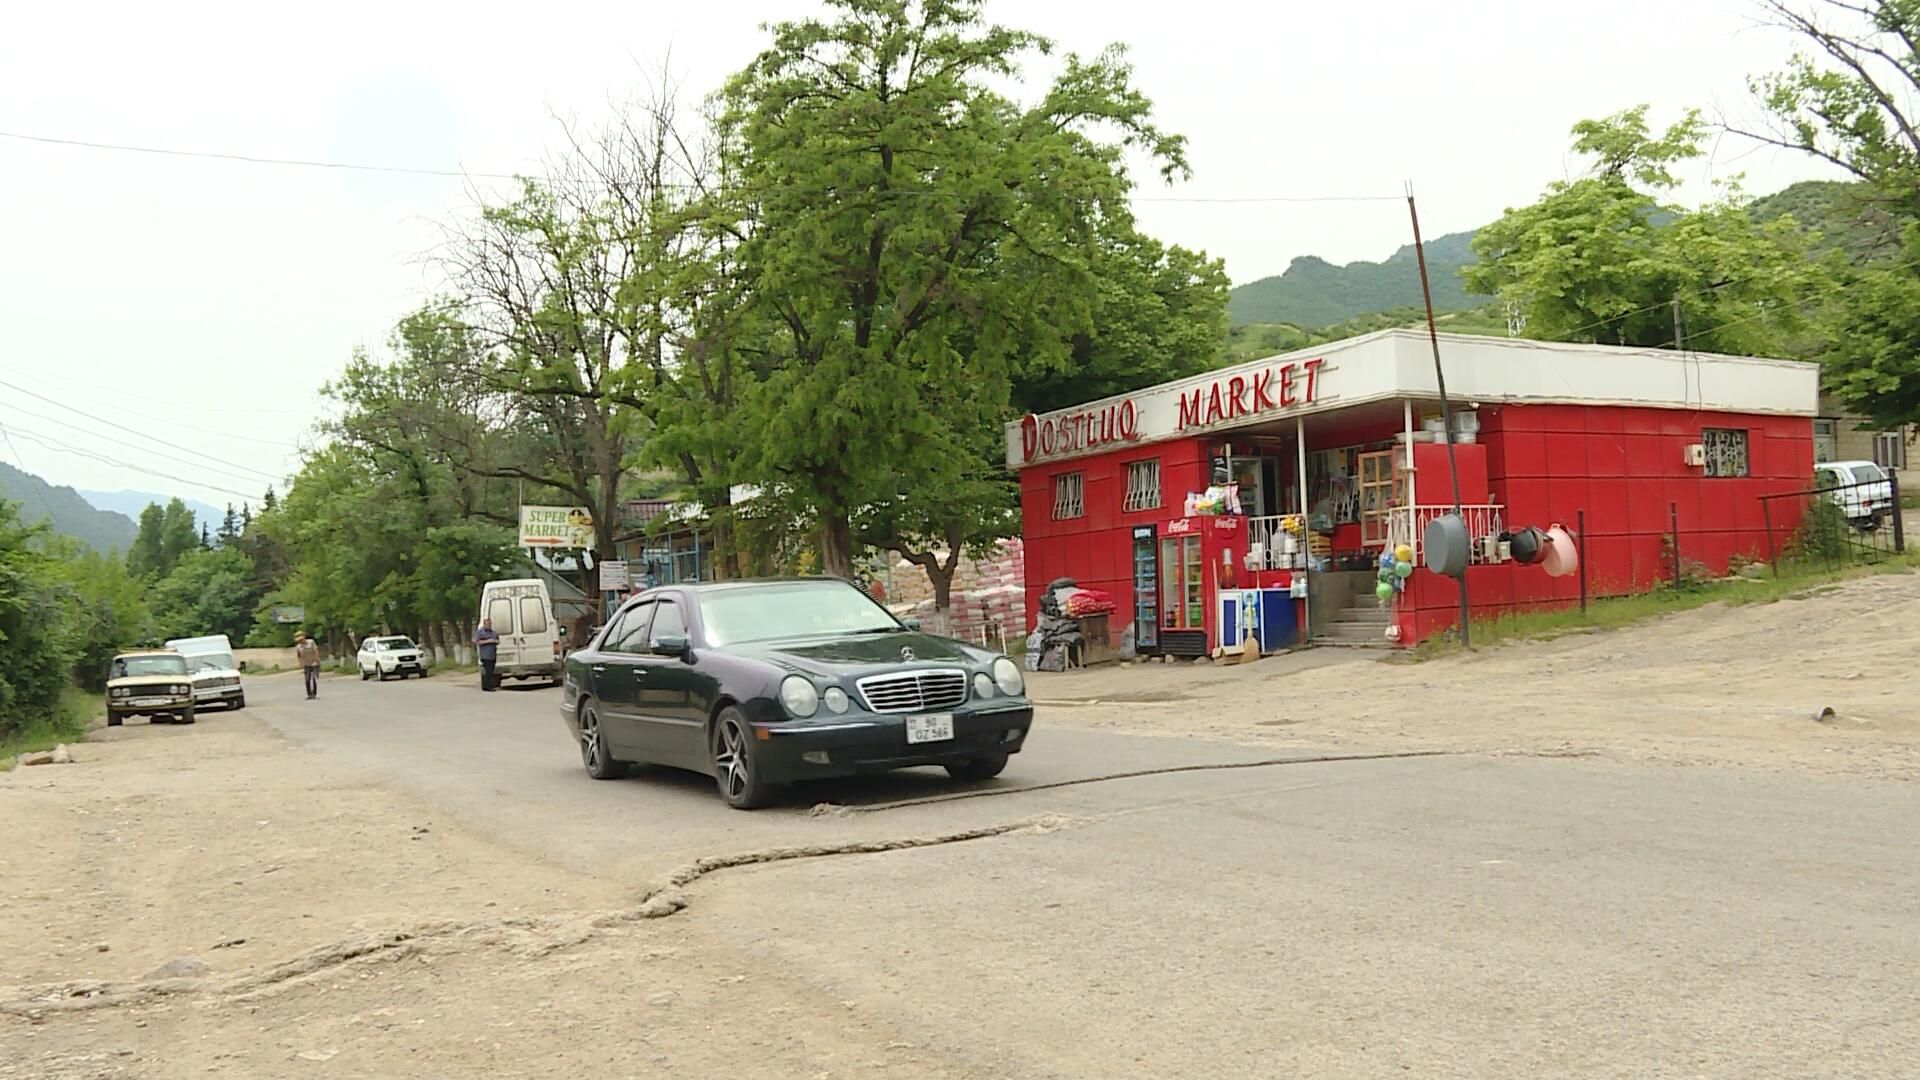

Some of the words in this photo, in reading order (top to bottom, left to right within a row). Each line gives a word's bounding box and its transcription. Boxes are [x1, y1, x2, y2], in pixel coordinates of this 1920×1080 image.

[1178, 358, 1323, 431] MARKET
[528, 509, 567, 523] SUPER
[523, 523, 569, 537] MARKET
